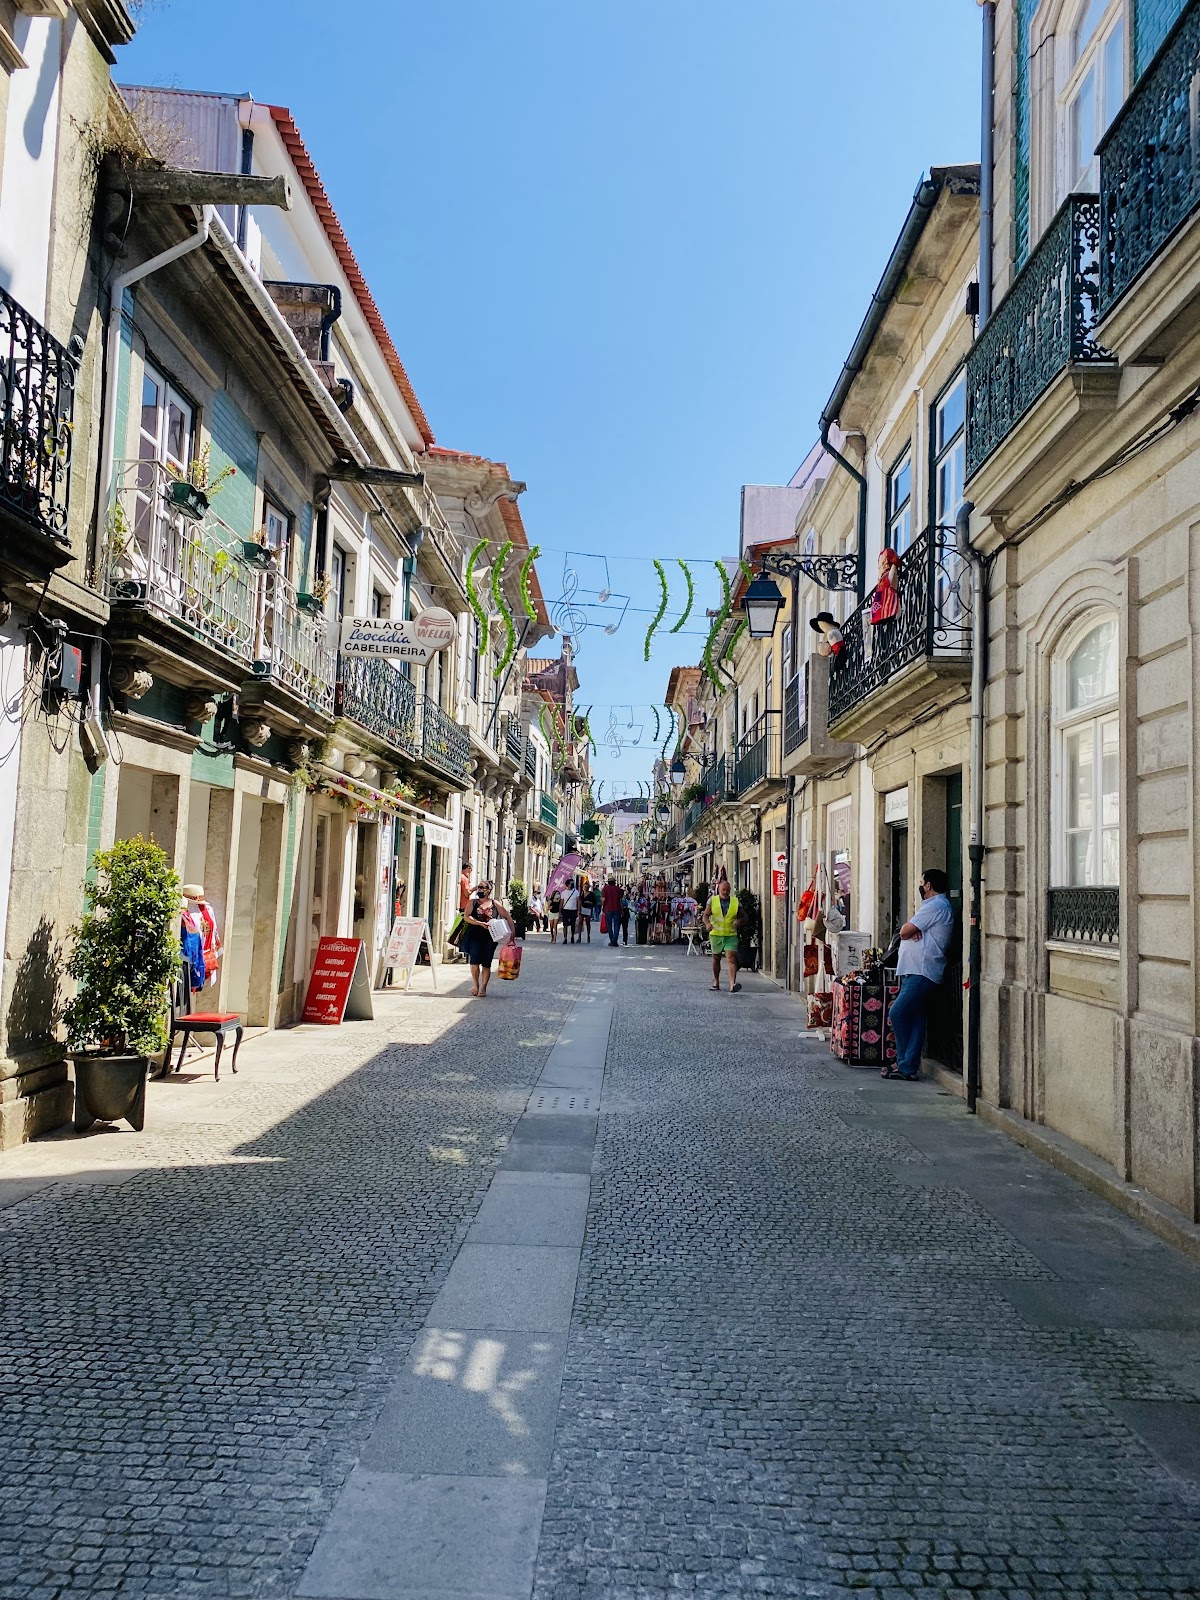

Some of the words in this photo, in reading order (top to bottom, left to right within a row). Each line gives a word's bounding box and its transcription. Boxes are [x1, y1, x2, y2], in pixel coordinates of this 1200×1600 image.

[353, 619, 404, 631] SALÃO
[349, 628, 411, 644] Leocádia
[417, 628, 451, 640] WELLA
[344, 642, 427, 657] CABELEIREIRA
[322, 981, 337, 989] BOLSAS
